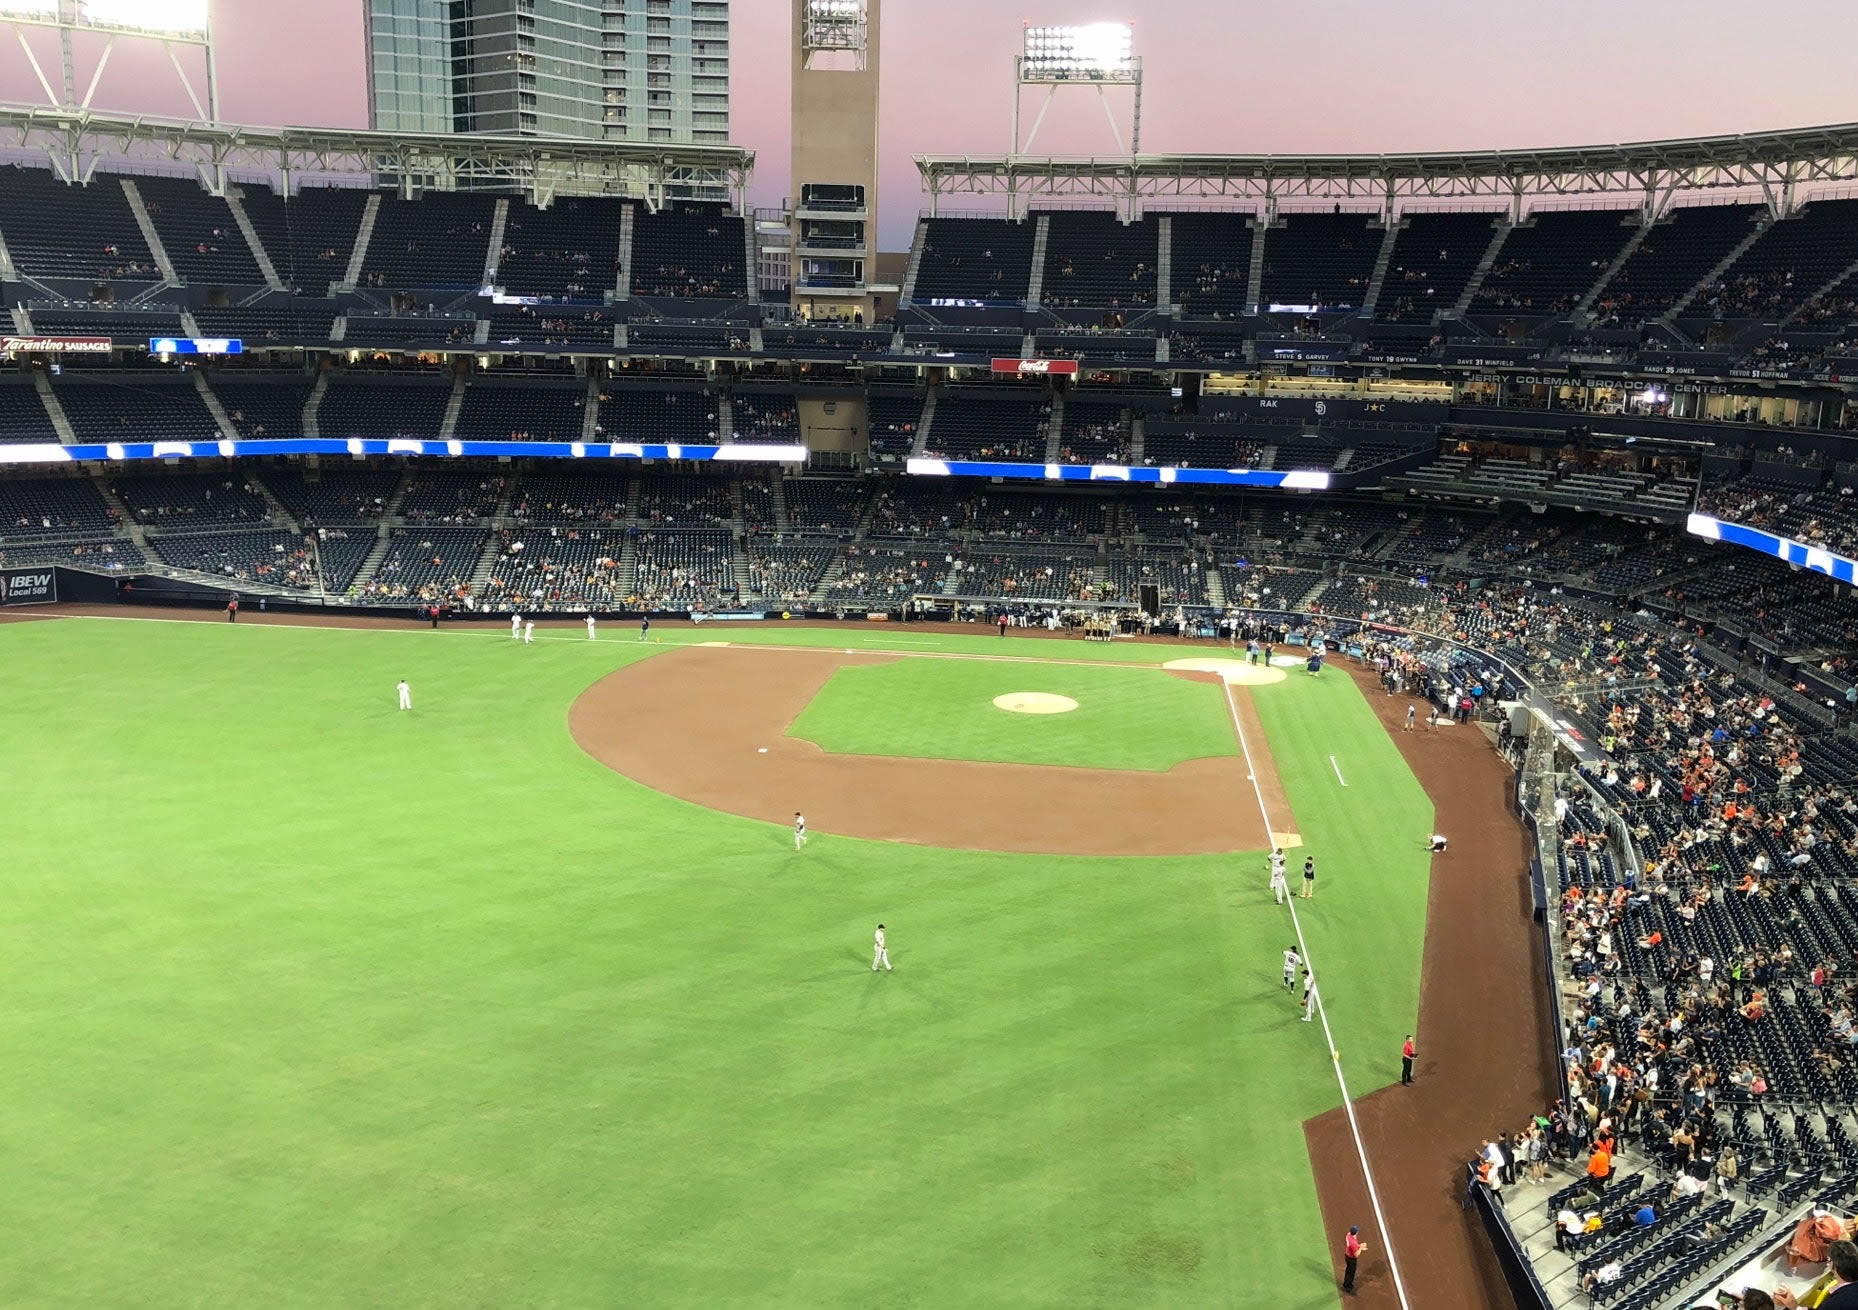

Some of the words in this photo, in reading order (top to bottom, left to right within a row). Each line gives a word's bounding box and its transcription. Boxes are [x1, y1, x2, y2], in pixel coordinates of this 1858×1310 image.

[2, 337, 63, 350] Tarantino
[64, 342, 111, 351] SAUSAGES
[1386, 355, 1394, 363] 19
[1665, 366, 1675, 374] 35
[1675, 367, 1696, 375] JONES
[1729, 369, 1751, 377] TREVOR
[1751, 370, 1760, 378] 51
[1760, 371, 1789, 379] HOFFMAN
[1468, 374, 1510, 383] JERRY
[1515, 376, 1581, 387] COLEMAN
[1586, 379, 1670, 391] BROADCAST
[1674, 383, 1728, 395] CENTER
[1260, 400, 1278, 408] RAK
[10, 574, 52, 588] IBEW
[9, 587, 32, 597] Local
[32, 586, 48, 595] 569
